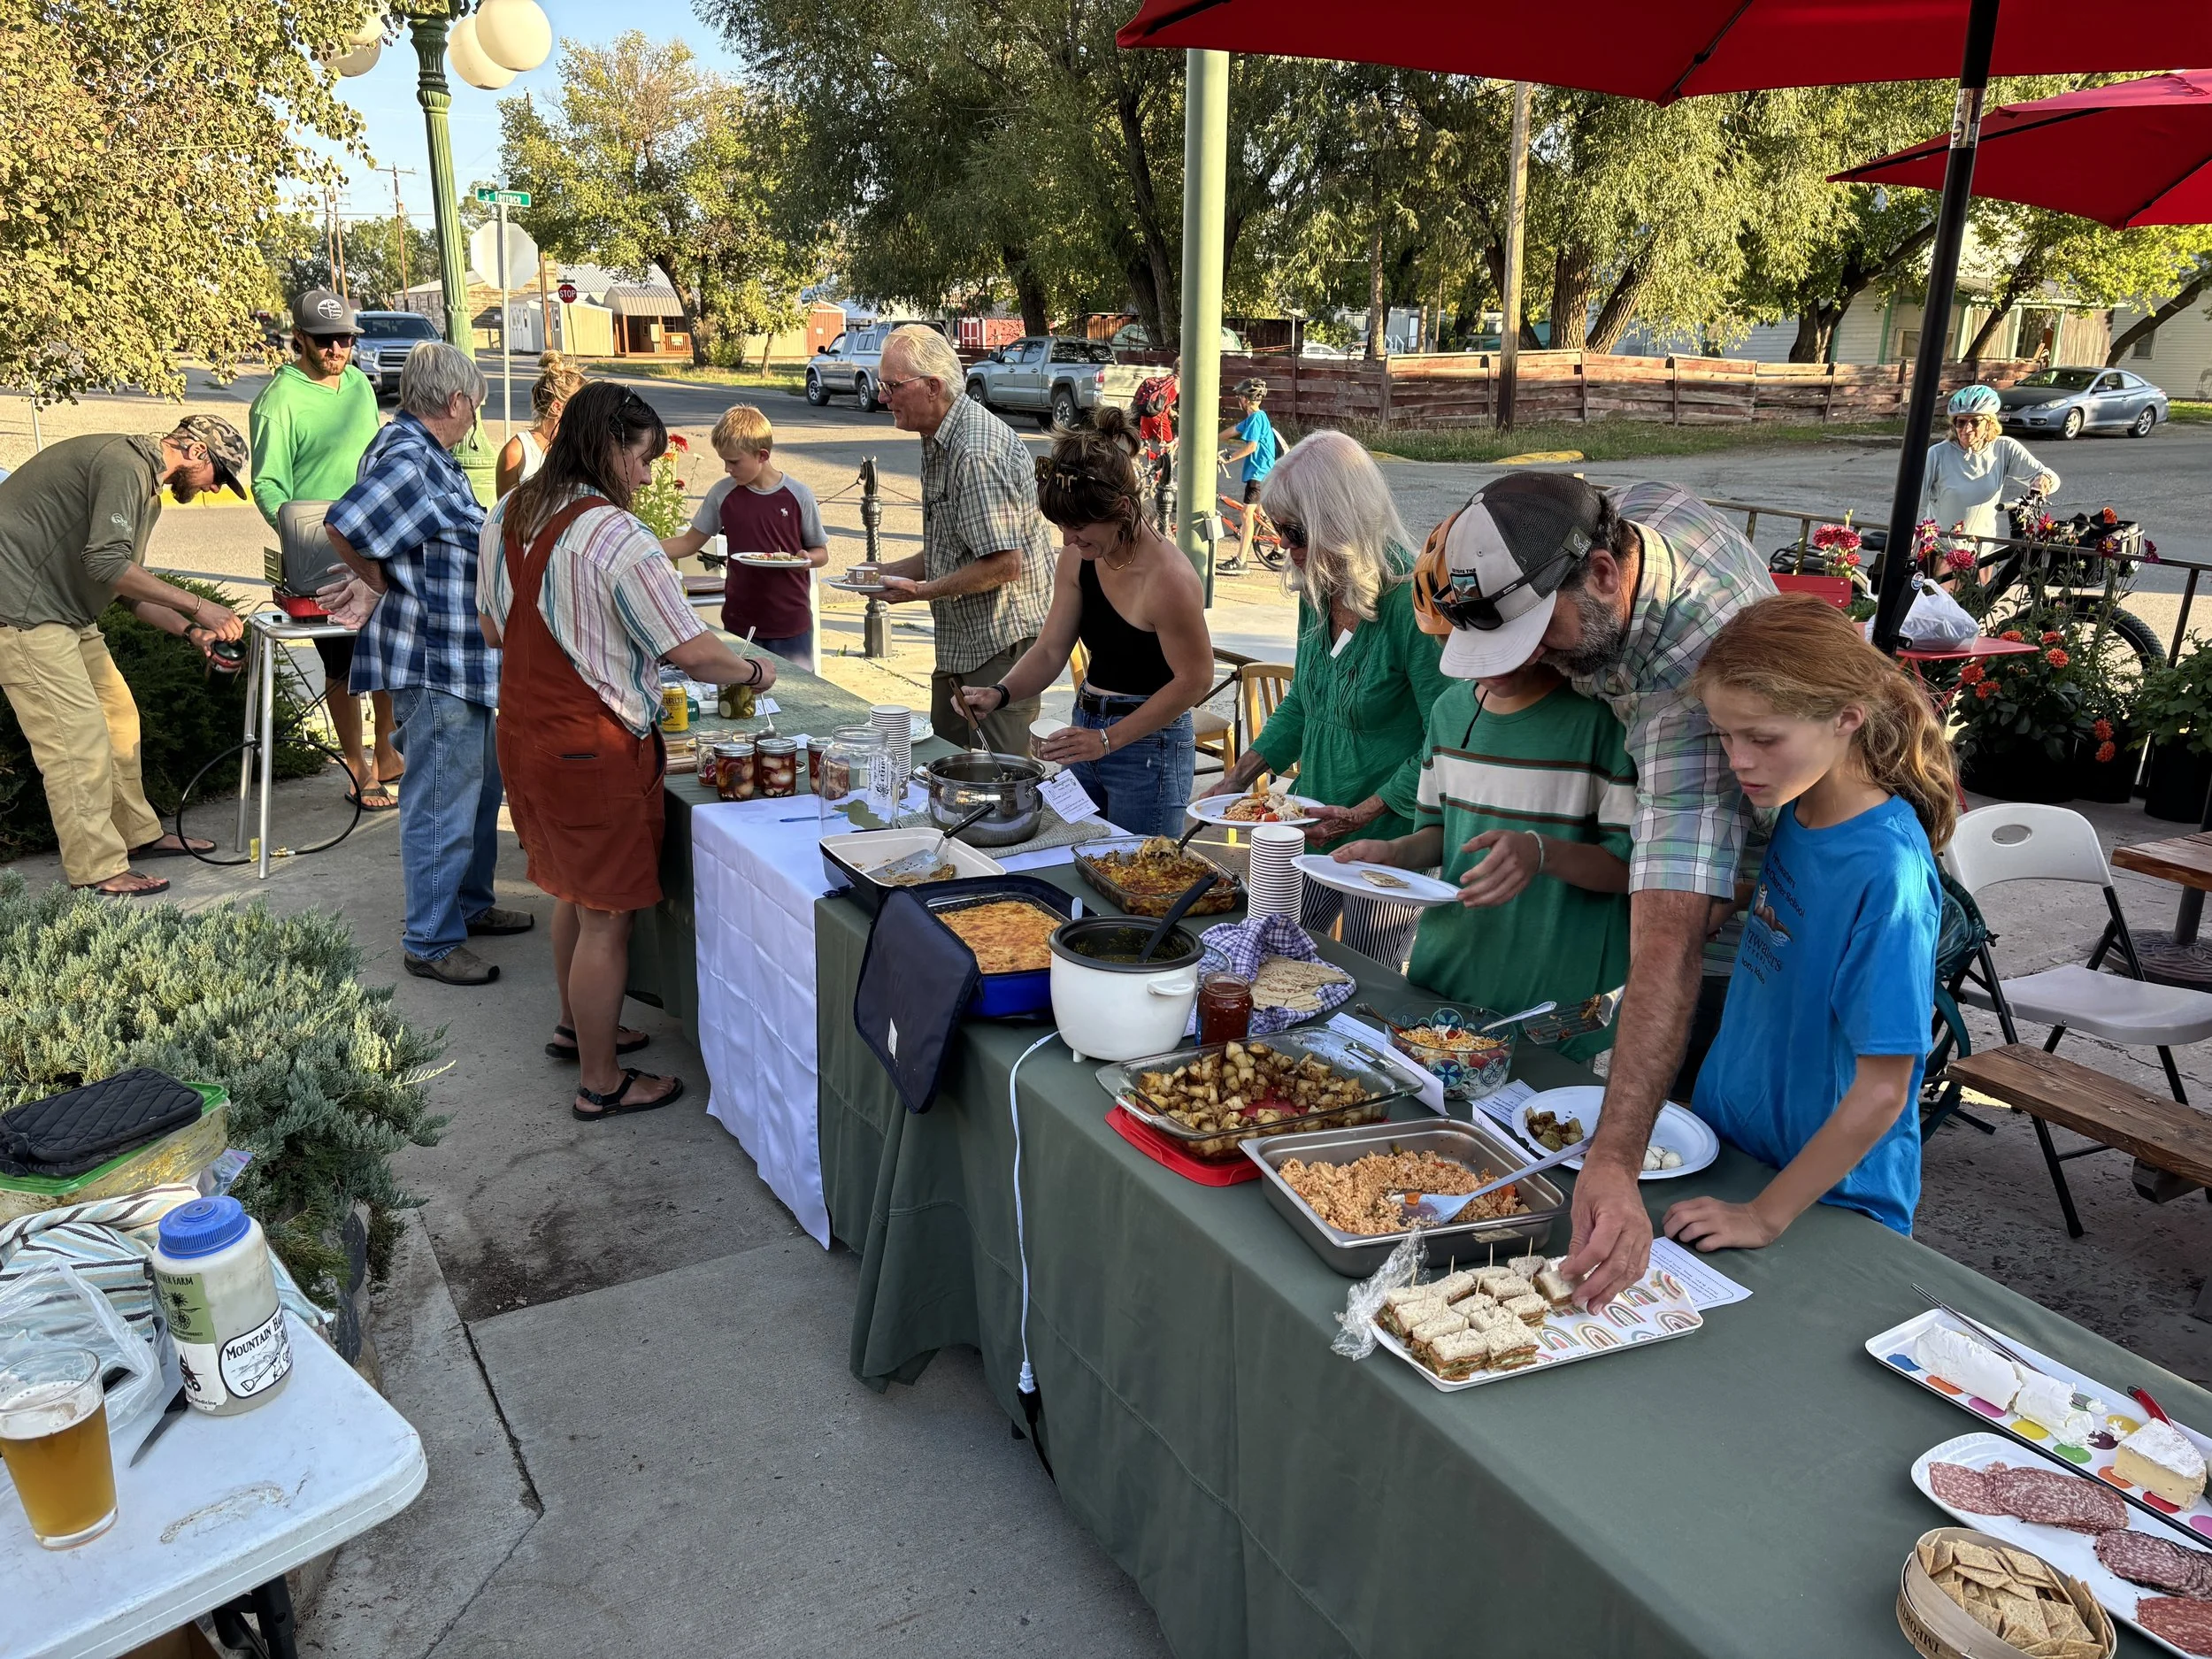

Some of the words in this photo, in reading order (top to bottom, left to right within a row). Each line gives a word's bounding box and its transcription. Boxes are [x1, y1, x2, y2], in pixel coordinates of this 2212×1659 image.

[484, 190, 490, 201] S
[495, 191, 522, 204] Terrace
[559, 289, 576, 298] STOP
[1786, 891, 1805, 918] School
[173, 1276, 194, 1286] FARM
[226, 1325, 272, 1361] MOUNTAIN
[1899, 1596, 1939, 1654] IMPORTE
